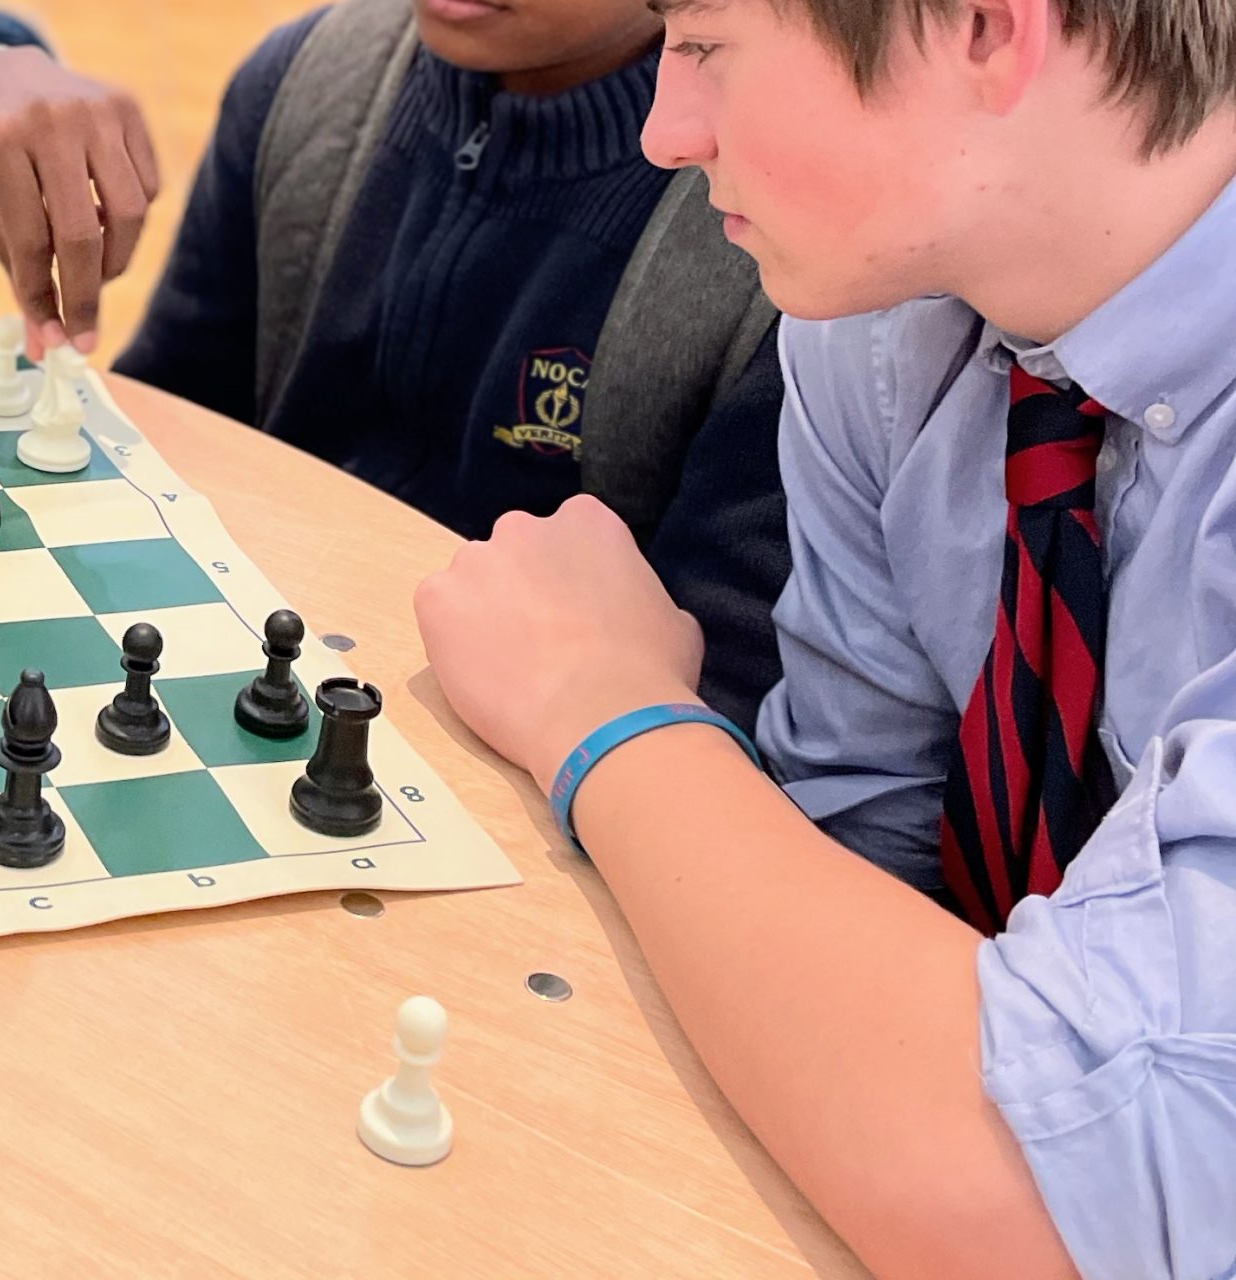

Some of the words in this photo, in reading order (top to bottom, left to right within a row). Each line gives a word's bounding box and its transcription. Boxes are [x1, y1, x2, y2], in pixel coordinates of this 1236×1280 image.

[211, 561, 230, 574] 5
[399, 785, 426, 802] 8
[351, 857, 377, 870] a
[187, 873, 217, 888] b
[28, 896, 53, 910] c
